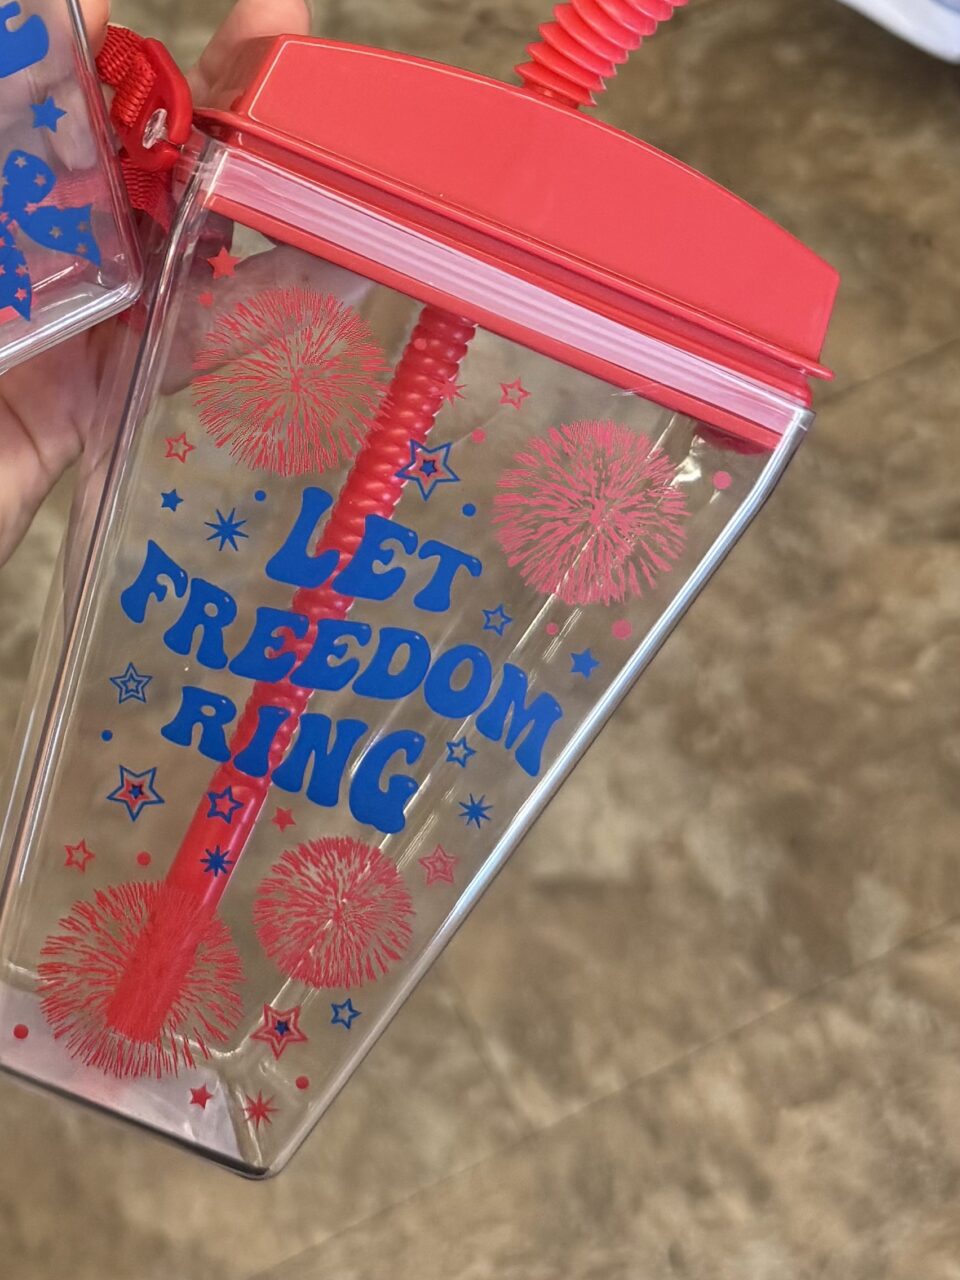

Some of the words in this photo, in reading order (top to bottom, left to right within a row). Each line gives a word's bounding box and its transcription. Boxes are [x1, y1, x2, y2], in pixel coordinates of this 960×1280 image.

[265, 486, 482, 612] LET
[120, 539, 564, 776] FREEDOM
[160, 686, 426, 833] RING
